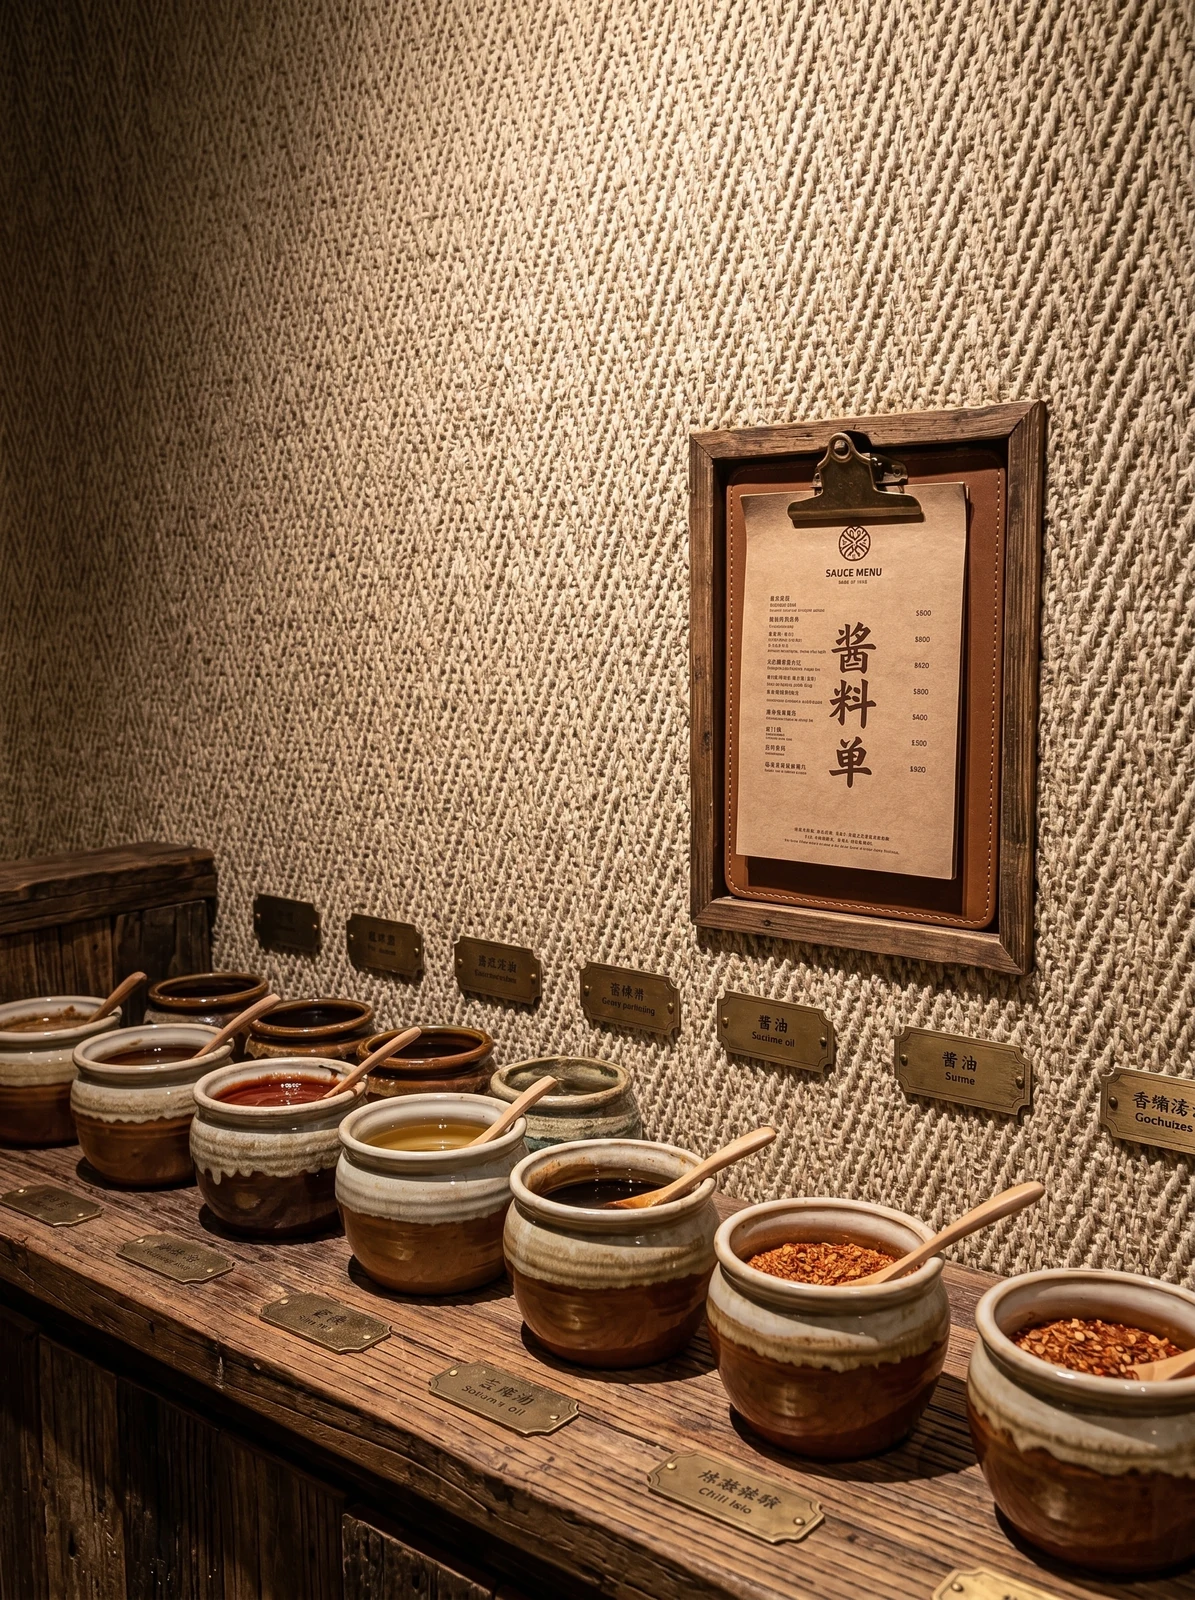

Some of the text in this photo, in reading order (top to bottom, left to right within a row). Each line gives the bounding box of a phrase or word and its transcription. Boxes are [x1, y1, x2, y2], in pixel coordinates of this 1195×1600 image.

[825, 567, 882, 578] SAUCE MENU
[829, 621, 877, 788] 酱料单
[942, 1051, 978, 1072] 酱油
